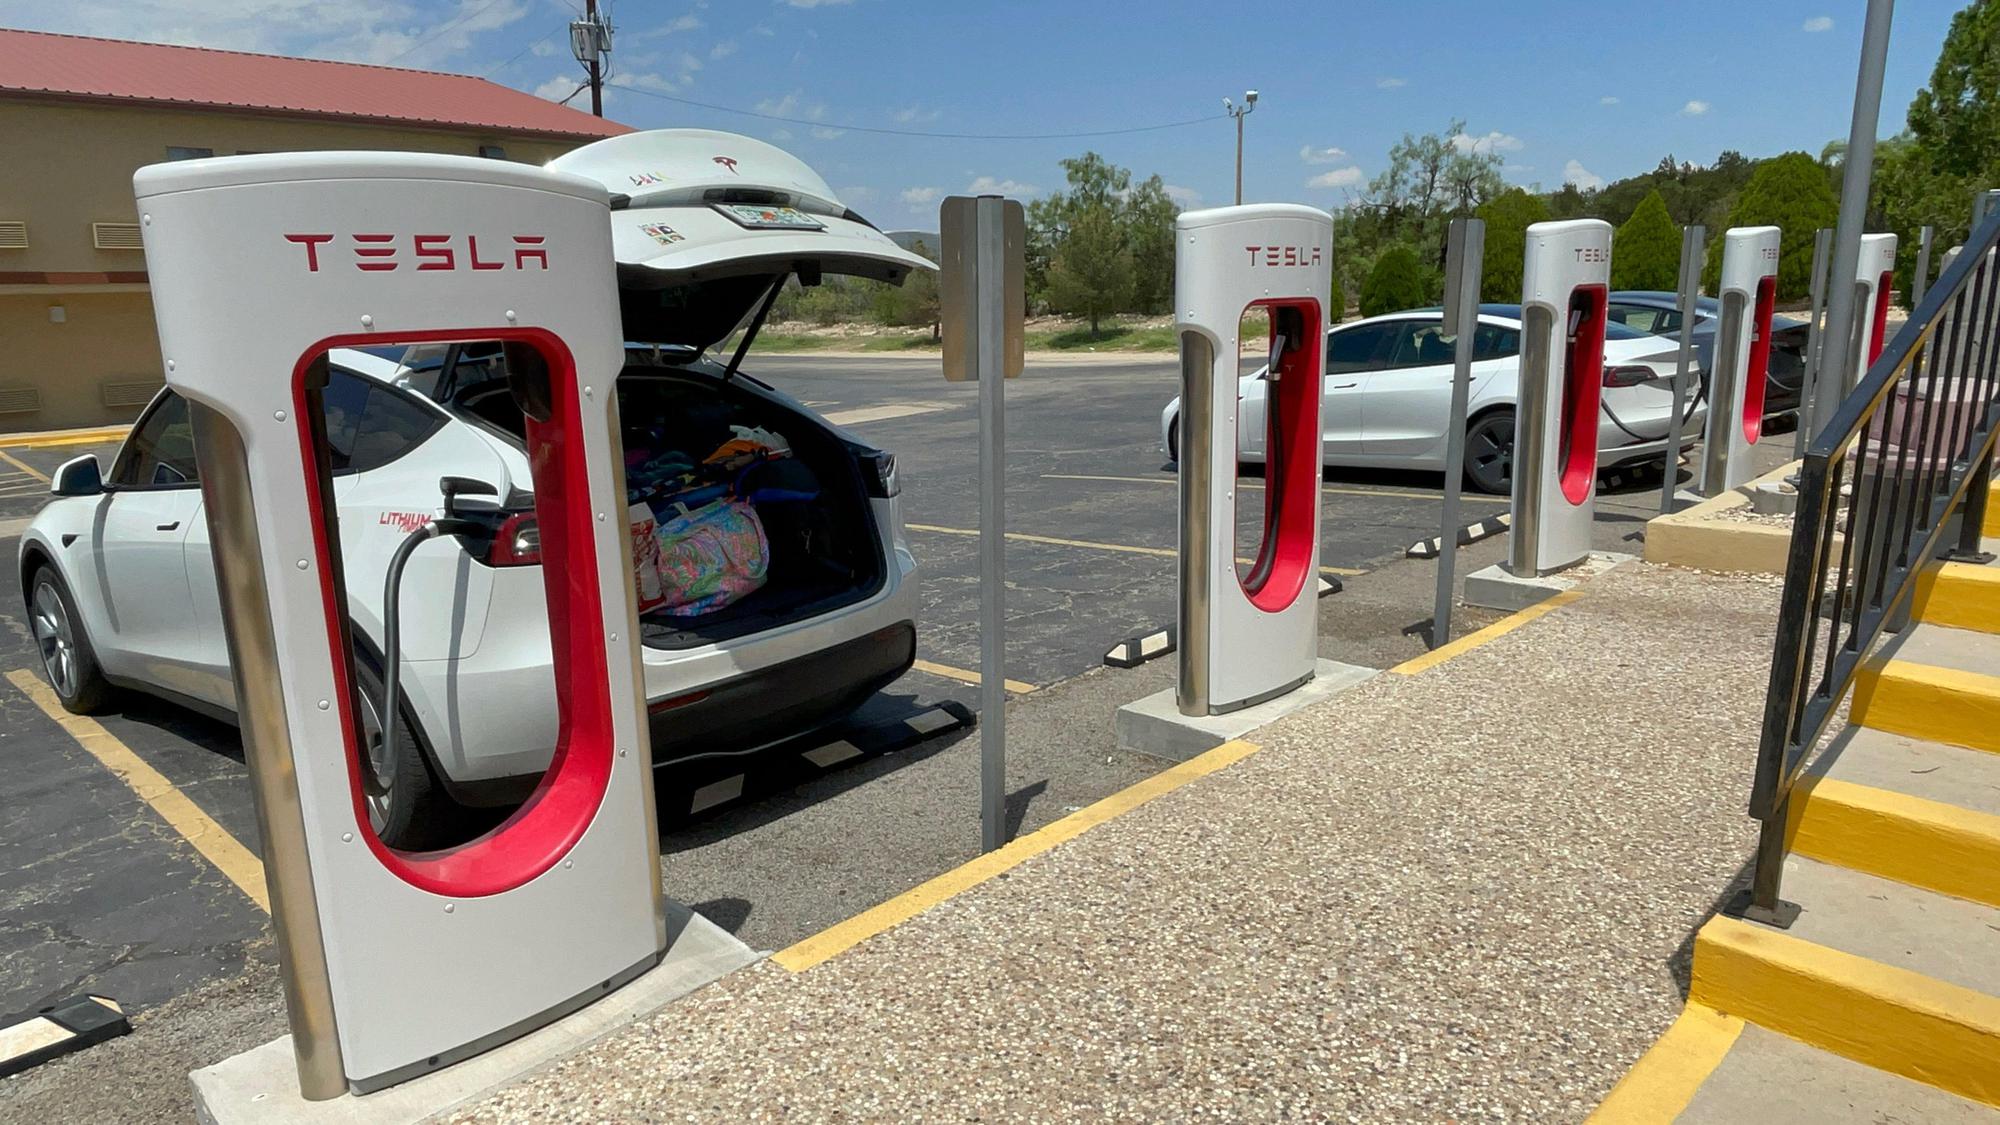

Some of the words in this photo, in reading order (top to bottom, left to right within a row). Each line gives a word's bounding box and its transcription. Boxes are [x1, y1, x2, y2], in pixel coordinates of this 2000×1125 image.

[283, 233, 549, 272] TESLA
[1245, 246, 1321, 267] TESLA
[379, 511, 432, 526] LITHIUM
